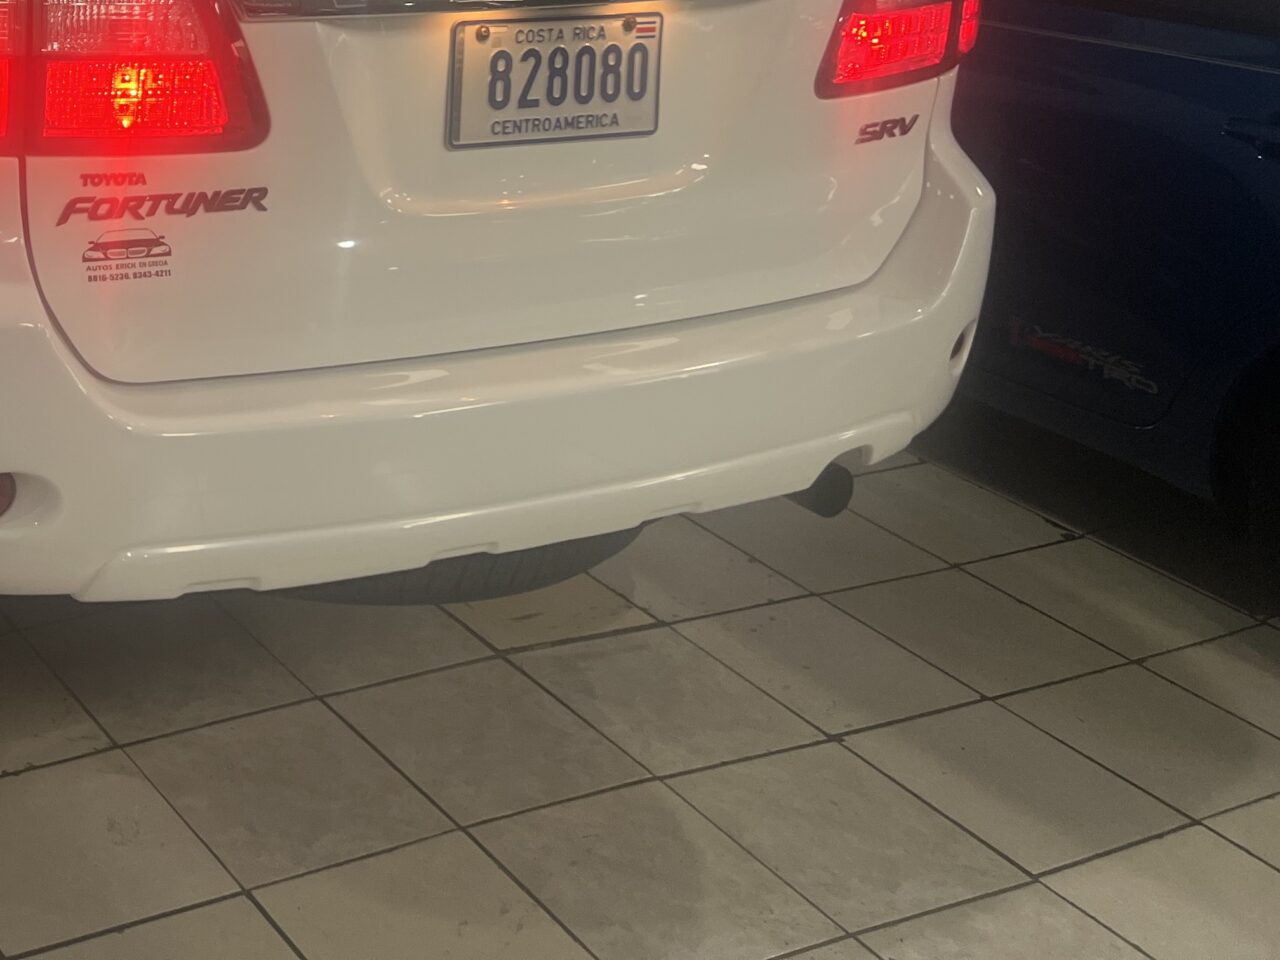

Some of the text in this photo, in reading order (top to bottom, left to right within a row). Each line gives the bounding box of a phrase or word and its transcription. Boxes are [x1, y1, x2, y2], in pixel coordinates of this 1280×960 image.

[515, 25, 607, 44] COSTA RICA
[488, 42, 649, 110] 828080
[491, 112, 620, 135] CENTROAMERICA
[854, 113, 920, 145] SRV
[80, 172, 147, 187] TOYOTA
[55, 186, 269, 227] FORTUNER
[86, 263, 113, 272] AUTOS
